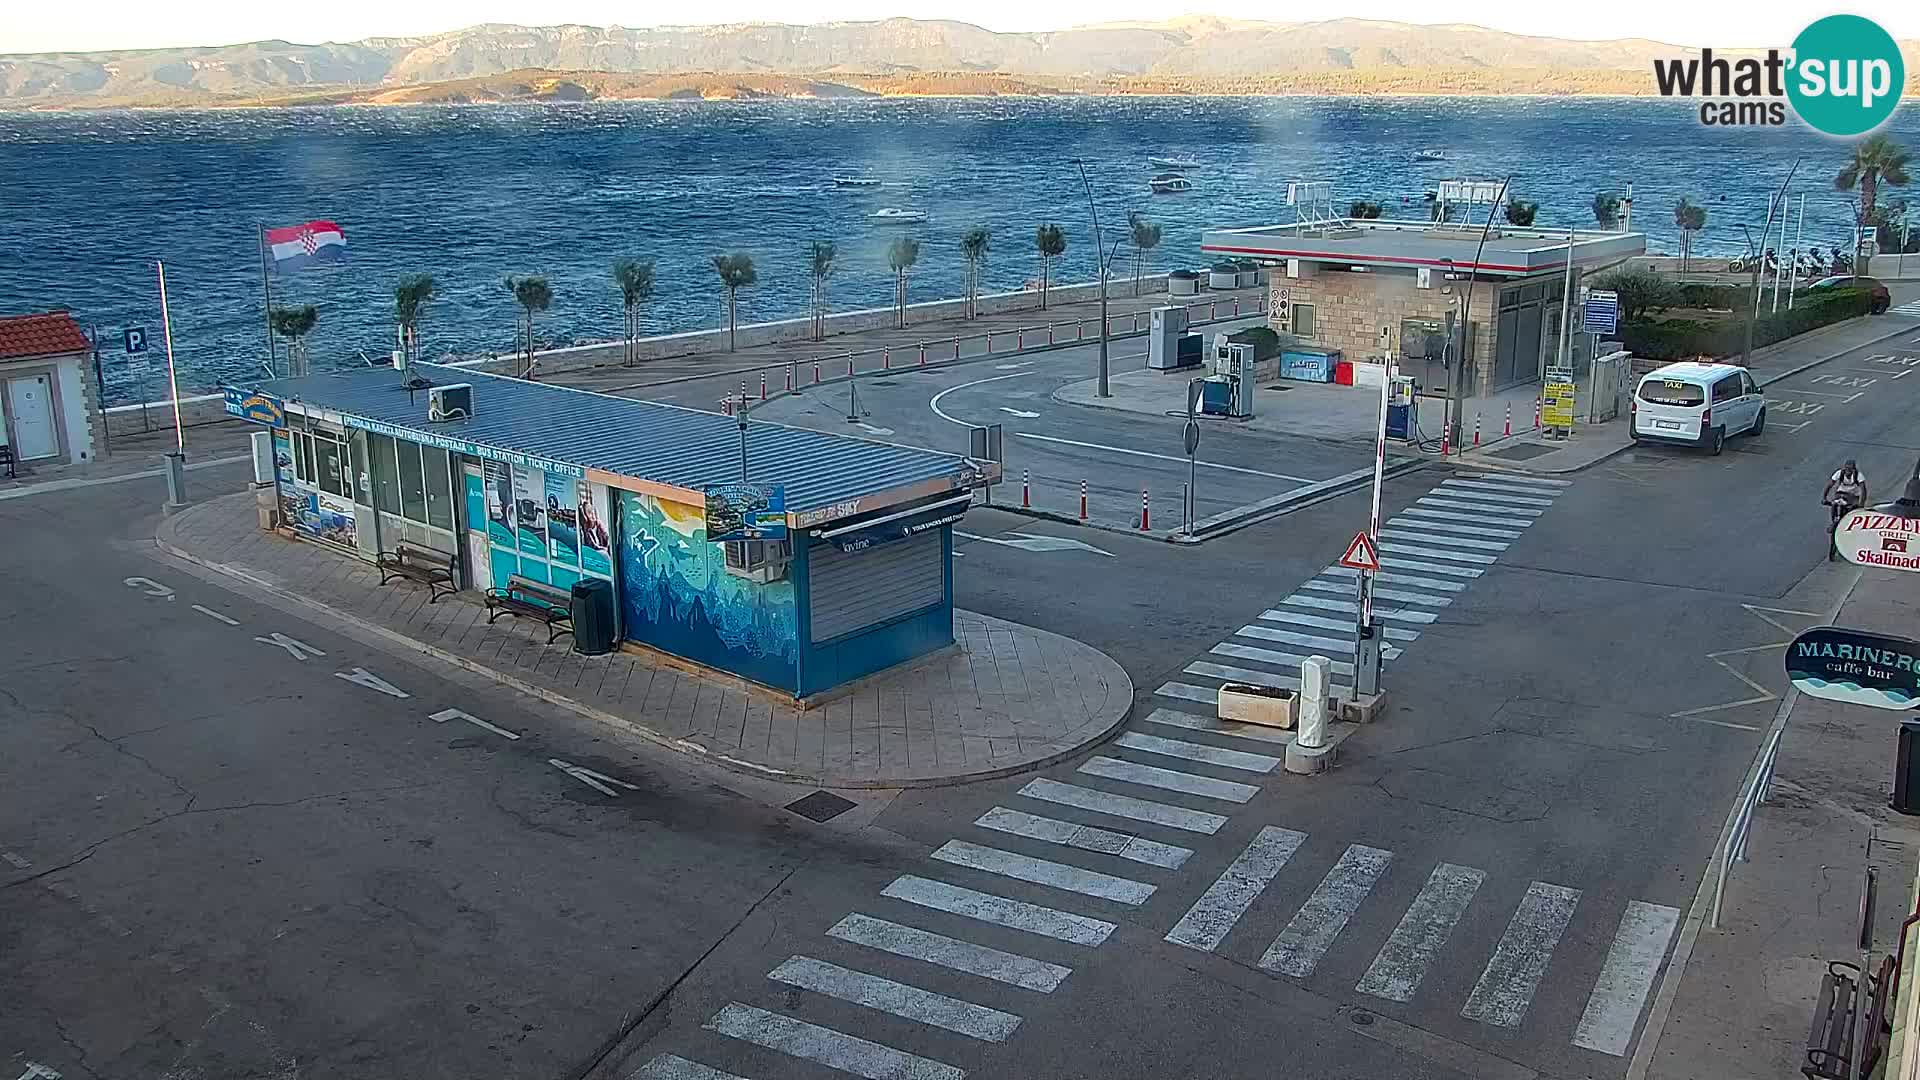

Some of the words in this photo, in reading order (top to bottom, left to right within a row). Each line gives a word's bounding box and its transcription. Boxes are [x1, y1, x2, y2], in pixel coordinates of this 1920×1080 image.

[130, 331, 141, 350] P
[1663, 381, 1683, 389] TAXI
[1810, 375, 1877, 388] TAXI
[1766, 399, 1825, 415] AXI
[395, 427, 435, 445] AUTOBUSNA
[436, 435, 467, 452] POSTAJA
[477, 446, 492, 458] BUS
[493, 450, 525, 465] STATION
[527, 457, 553, 471] TICKET
[554, 463, 581, 477] OFFICE
[1879, 530, 1913, 541] GRILL
[1826, 662, 1862, 675] caffe
[1868, 665, 1894, 680] bar
